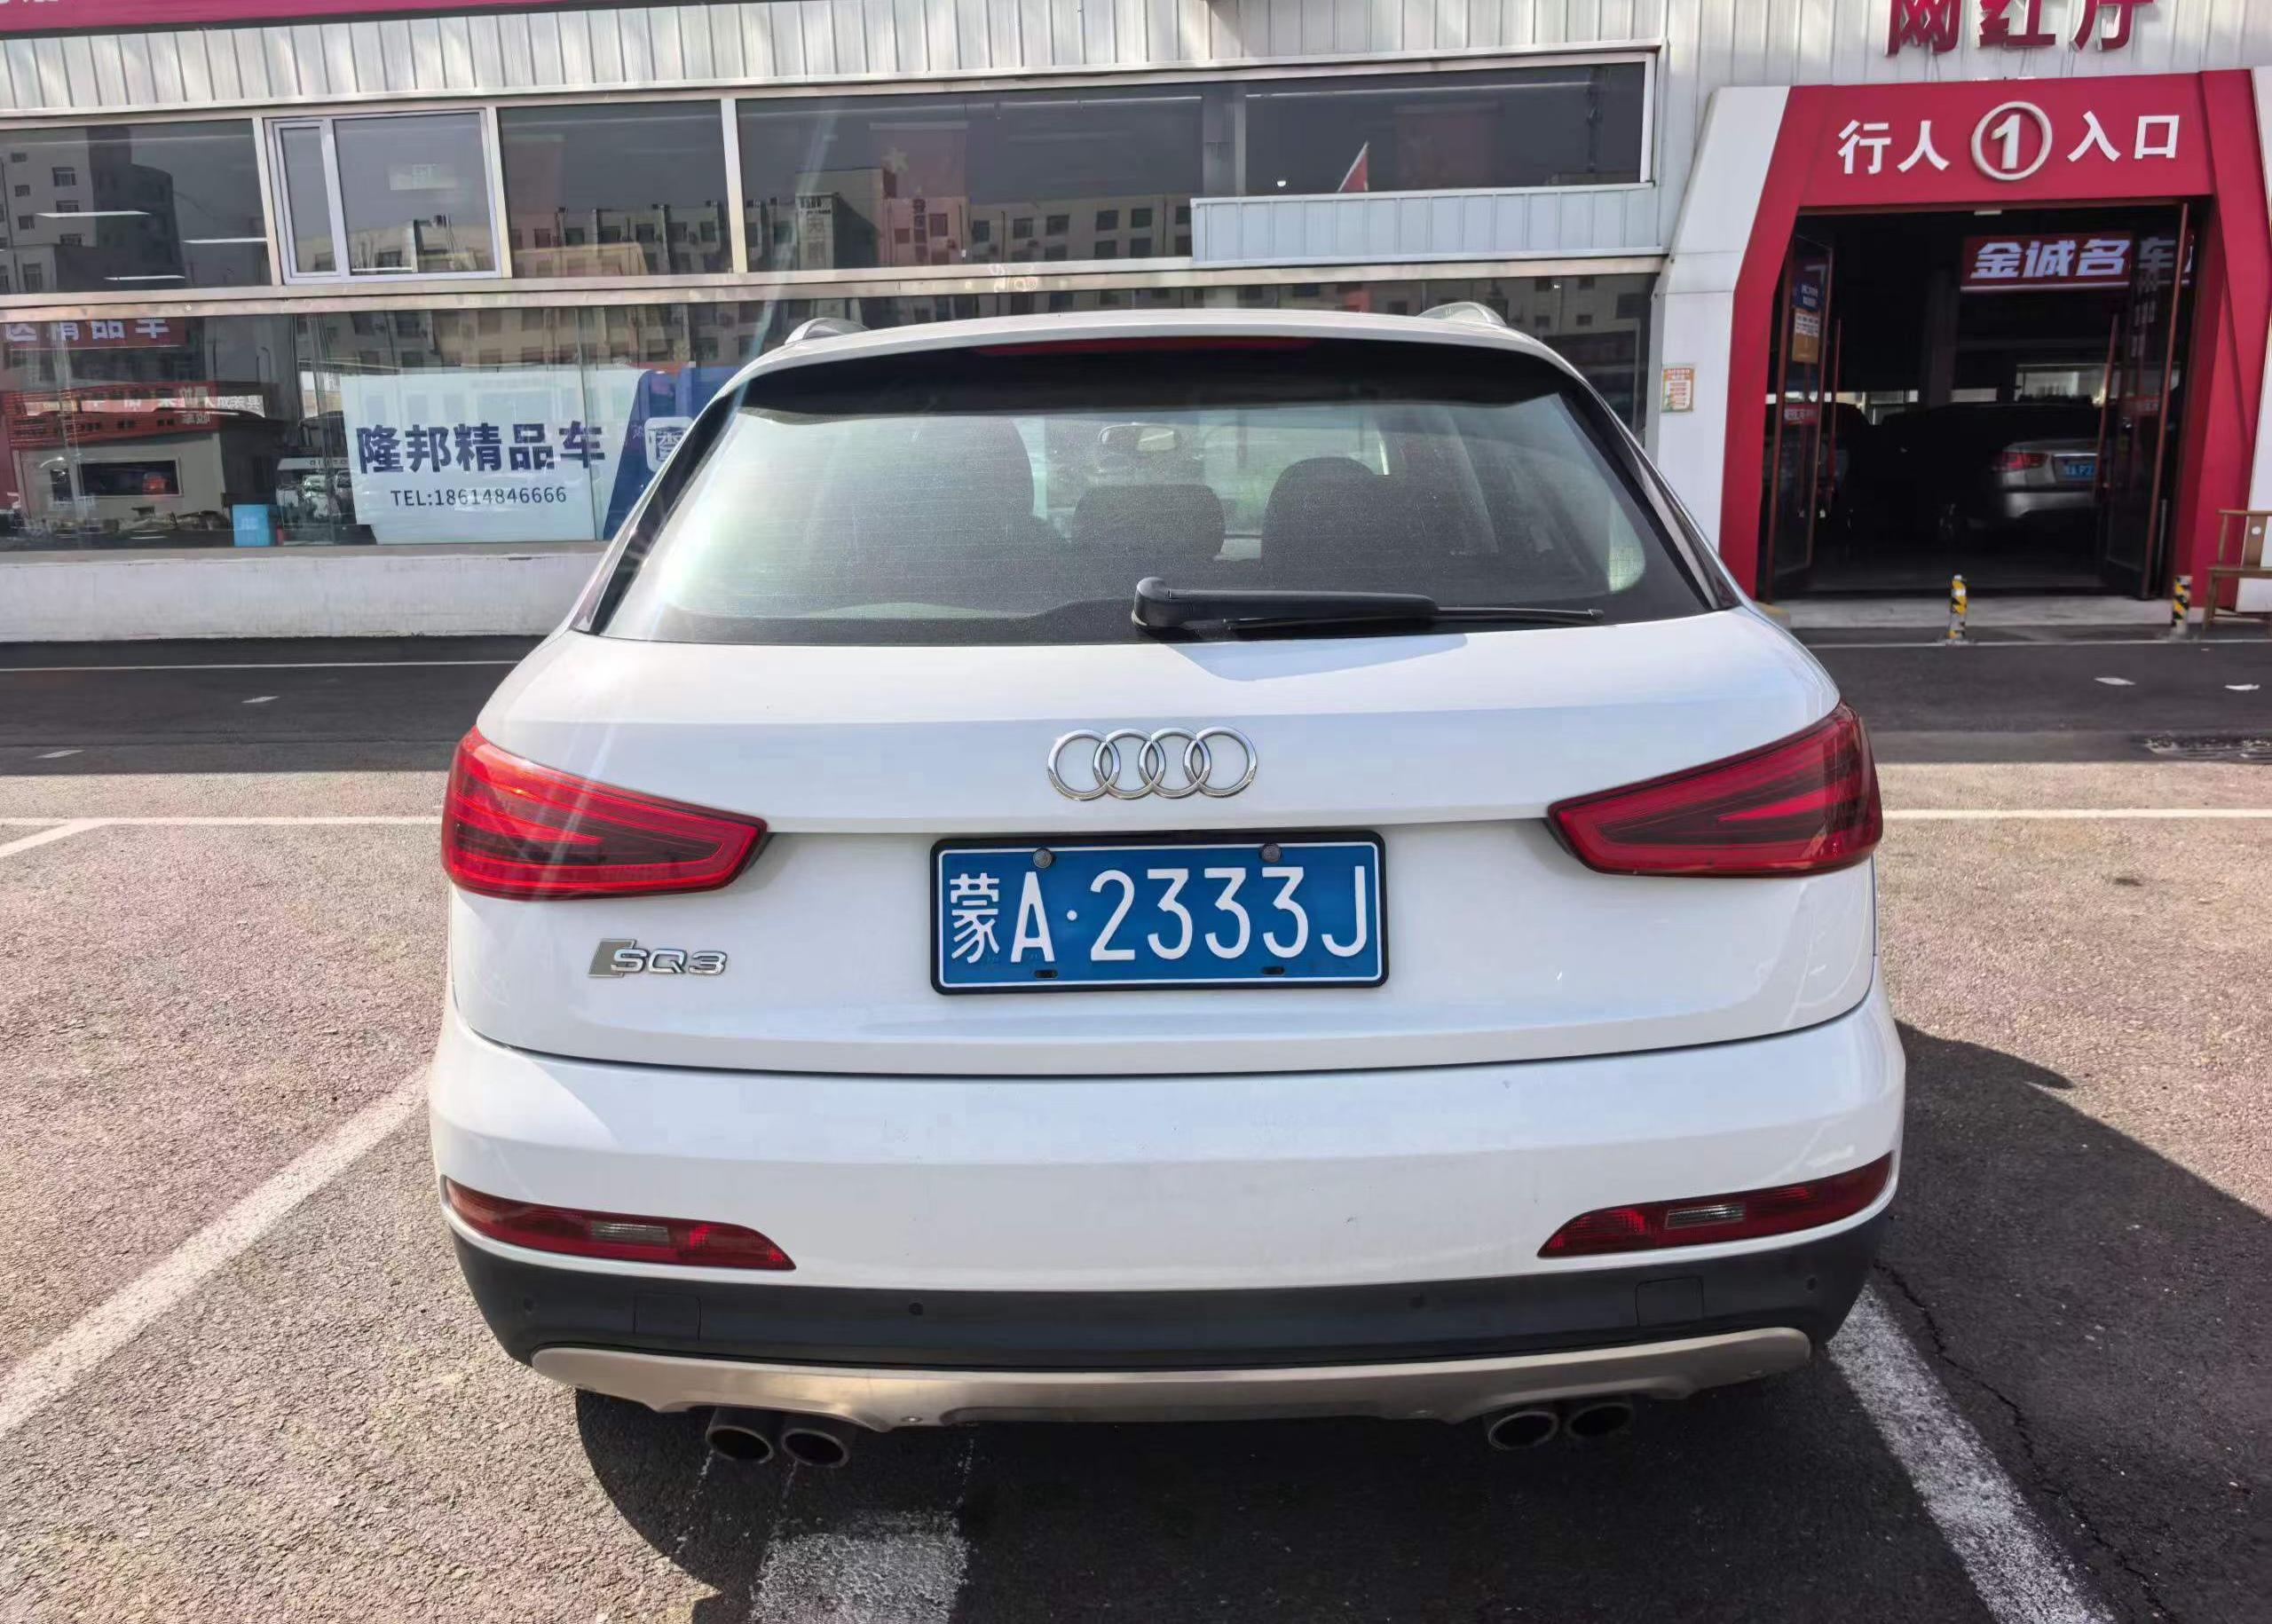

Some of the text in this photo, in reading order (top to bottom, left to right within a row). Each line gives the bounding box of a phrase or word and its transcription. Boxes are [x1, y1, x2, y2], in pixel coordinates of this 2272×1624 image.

[356, 421, 605, 474] 隆邦精品车
[390, 486, 567, 507] TEL:18614846666
[610, 948, 728, 975] SQ3
